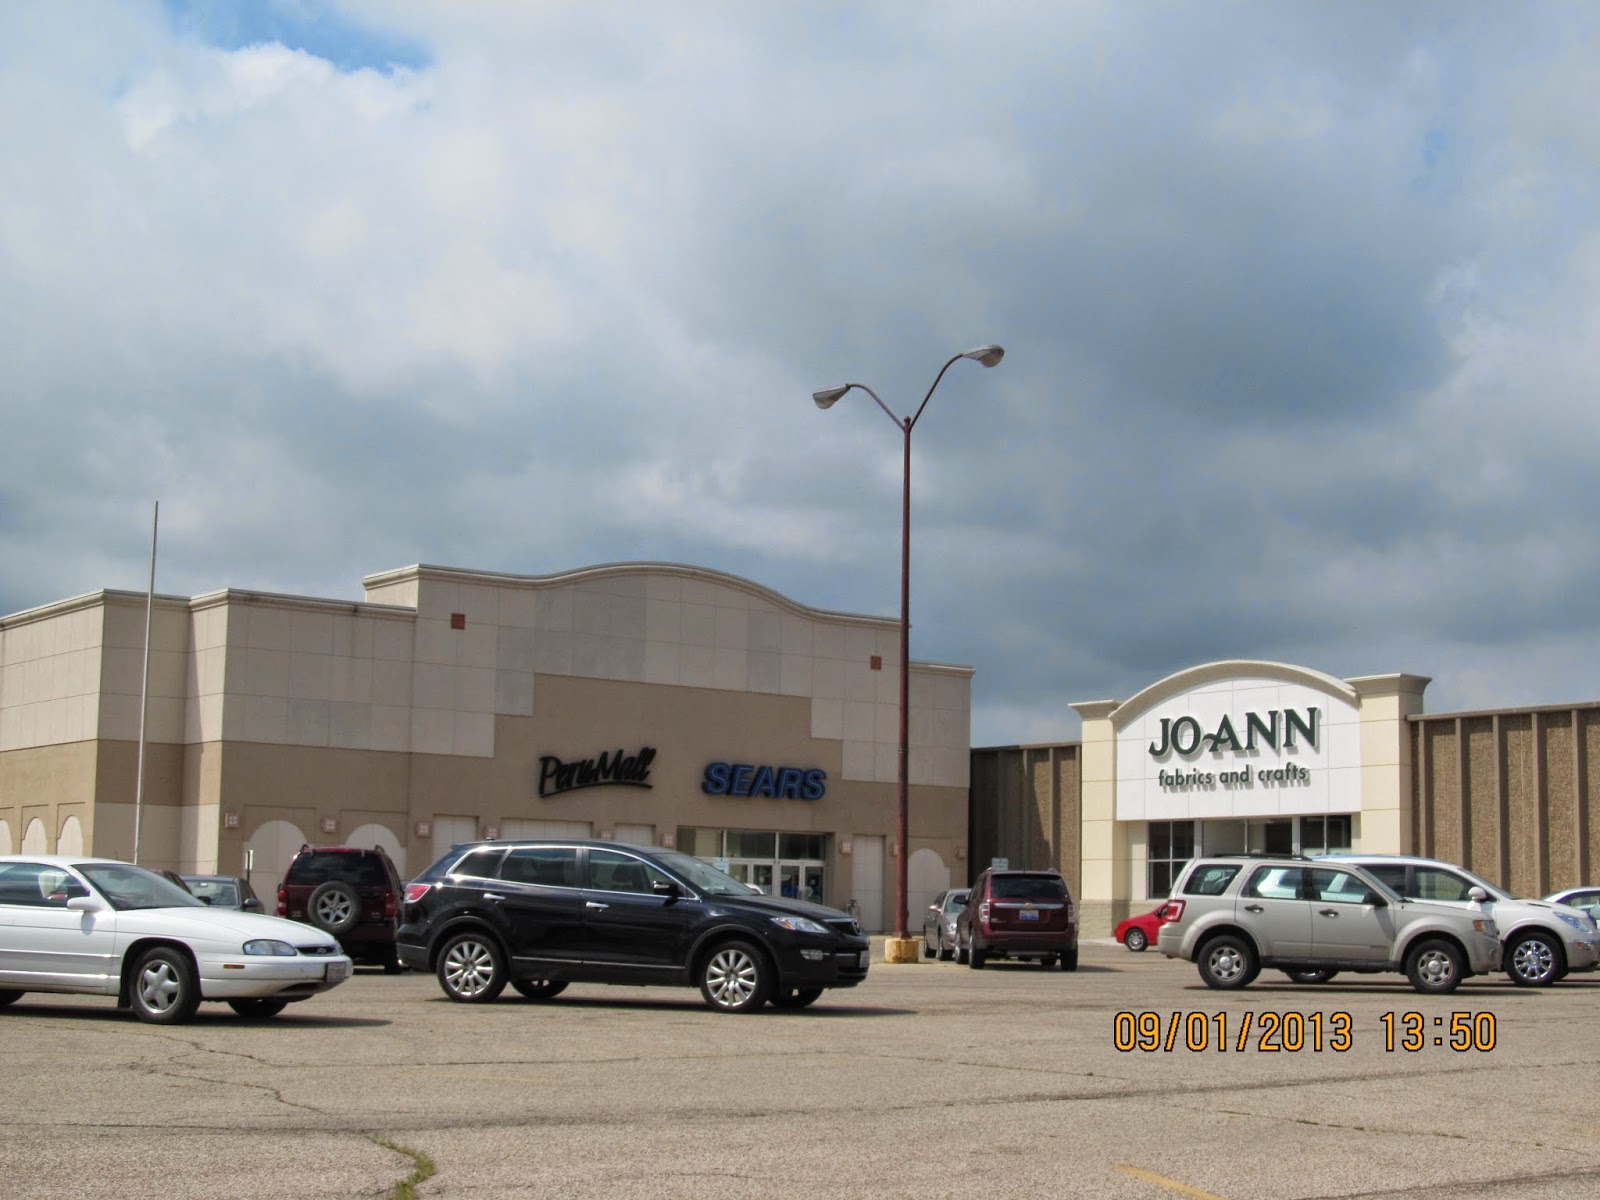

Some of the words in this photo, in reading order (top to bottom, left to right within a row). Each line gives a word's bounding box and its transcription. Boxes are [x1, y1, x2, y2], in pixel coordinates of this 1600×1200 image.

[538, 756, 598, 796] Peru
[597, 747, 657, 783] Mall
[702, 762, 827, 801] SEARS
[1158, 767, 1213, 787] fabrics
[1219, 764, 1250, 784] and
[1257, 761, 1308, 782] crafts
